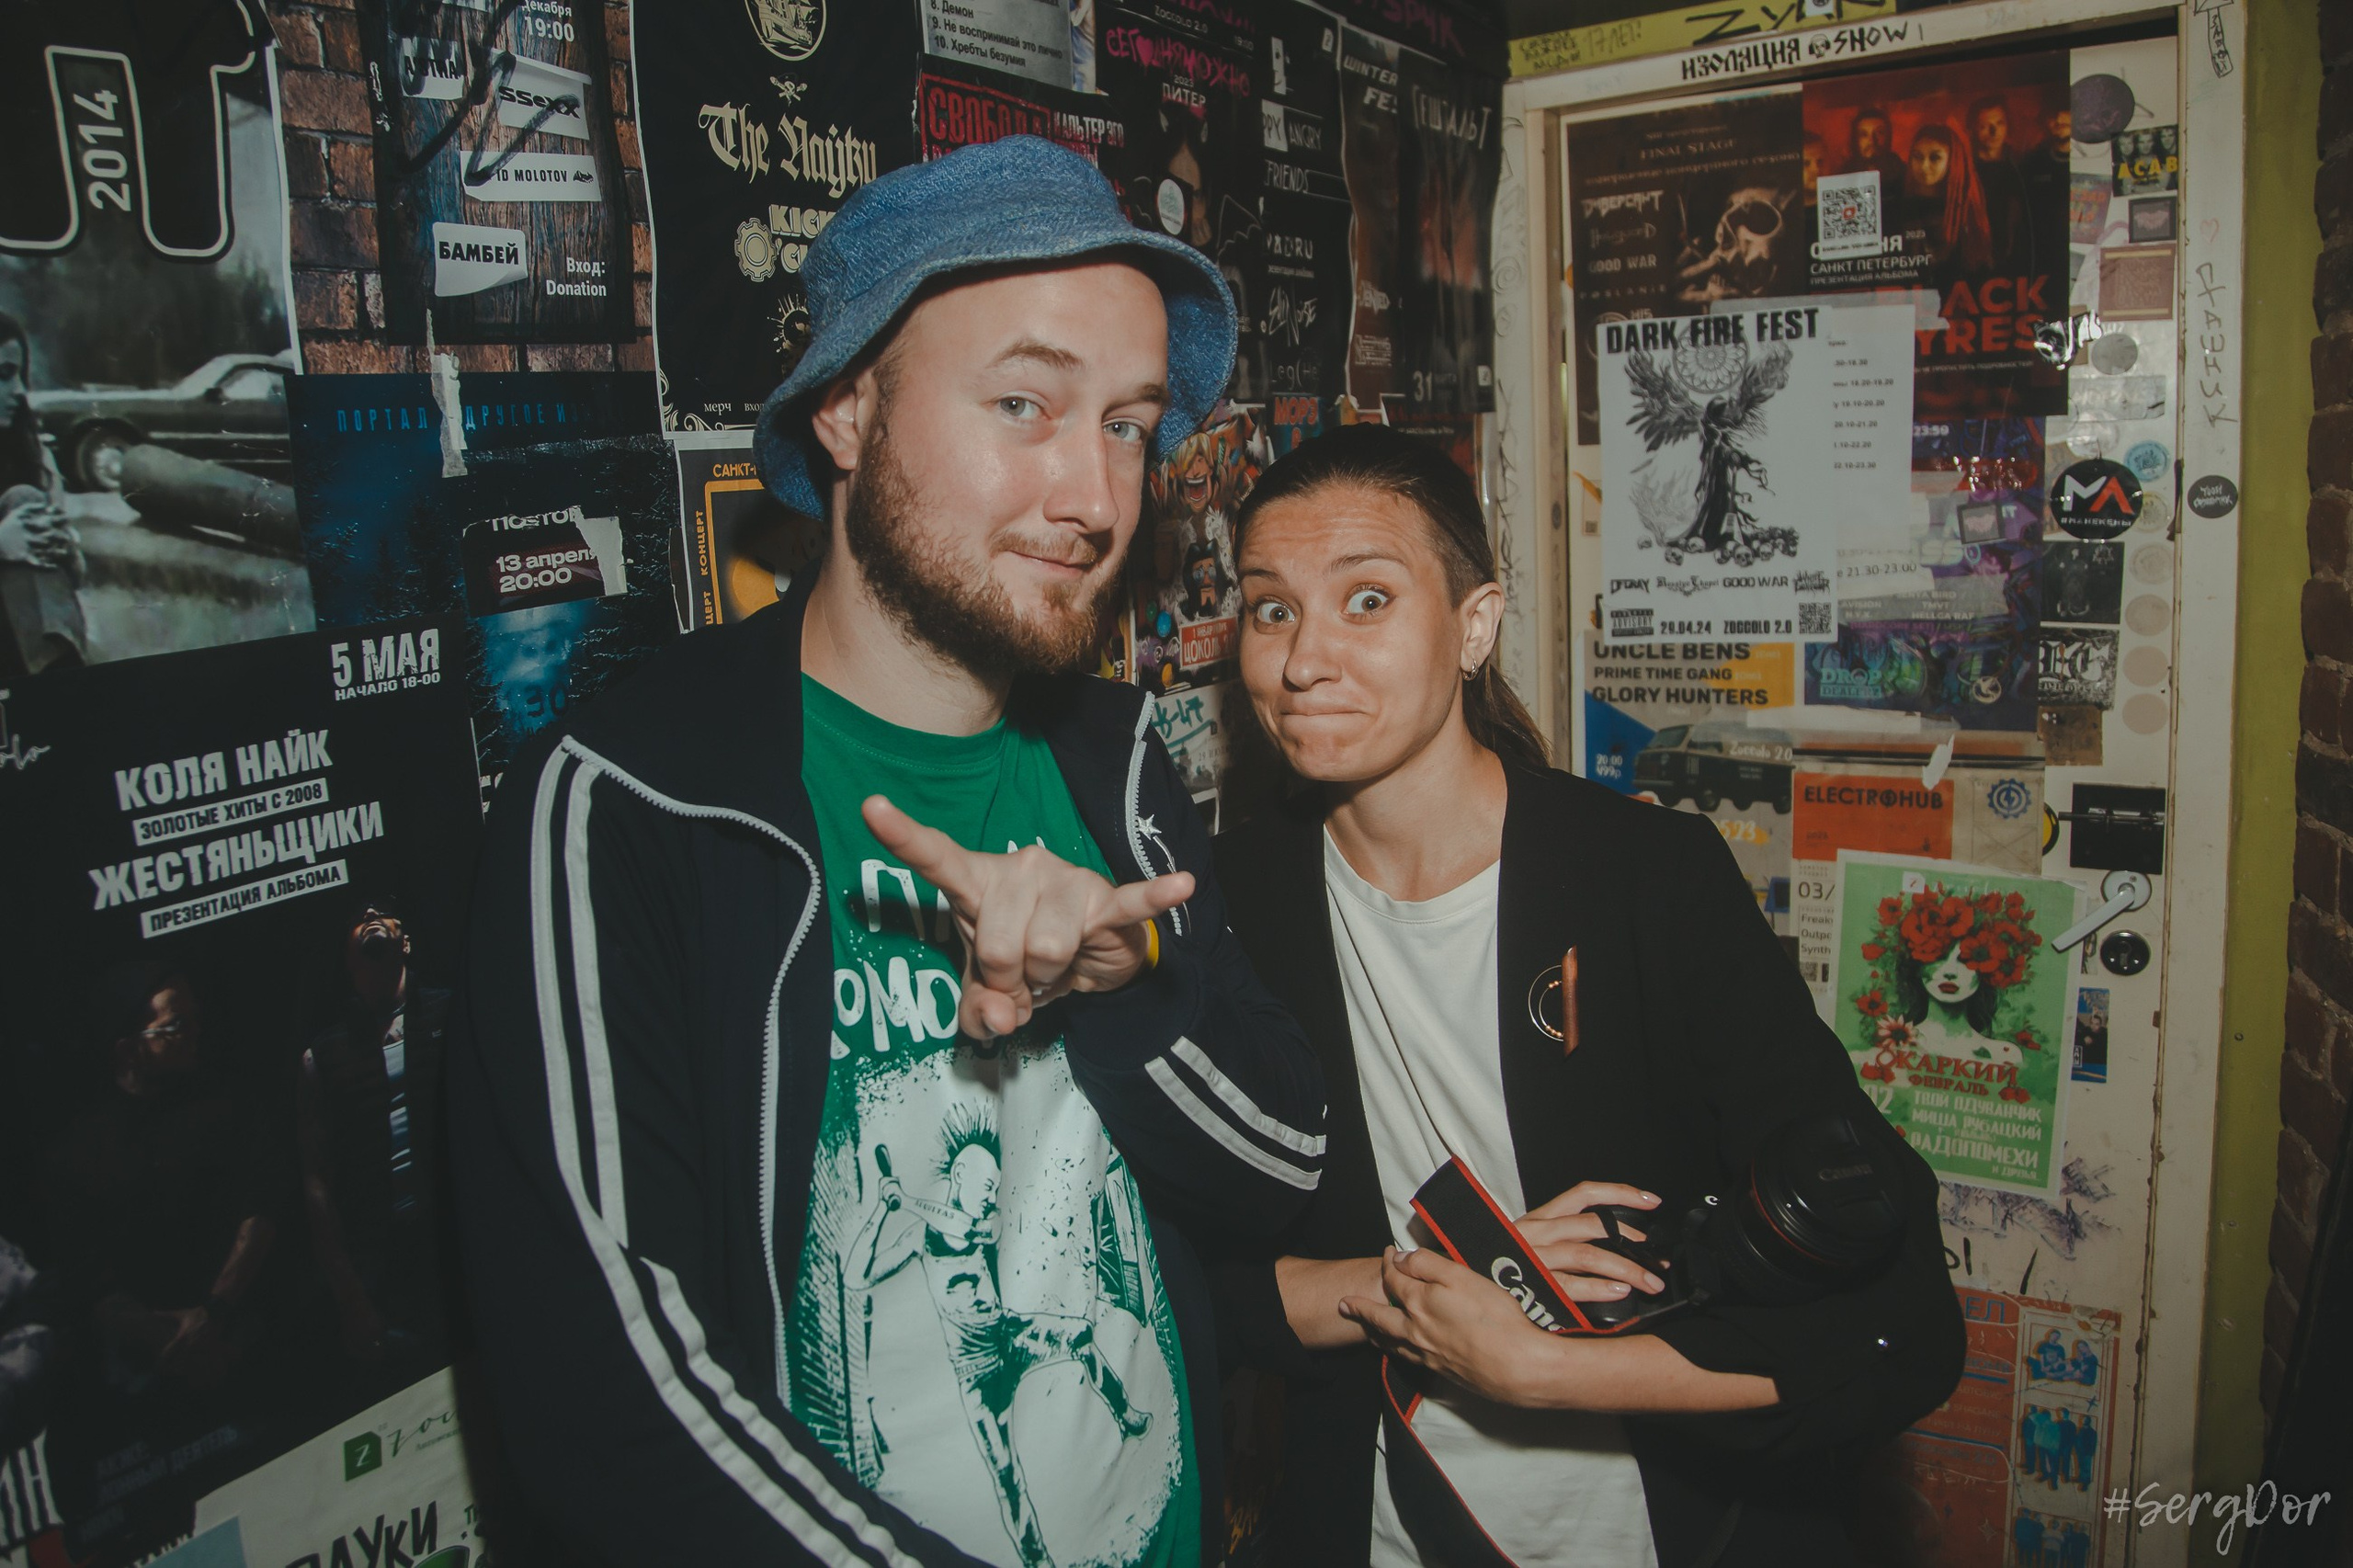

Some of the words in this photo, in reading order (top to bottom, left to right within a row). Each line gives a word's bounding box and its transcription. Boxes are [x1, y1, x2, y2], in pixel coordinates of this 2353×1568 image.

[942, 0, 974, 18] Демон
[524, 17, 574, 42] 19:00
[932, 17, 942, 29] 9.
[944, 19, 957, 33] Не
[960, 24, 1020, 48] воспринимай
[1022, 41, 1036, 52] это
[1038, 47, 1063, 60] лично
[935, 35, 949, 50] 10.
[951, 39, 988, 58] Хребты
[990, 47, 1027, 67] безумия
[1343, 54, 1399, 87] WINTER
[1162, 83, 1207, 108] ПИТЕР
[73, 89, 131, 212] 2014
[699, 102, 770, 184] The
[515, 169, 568, 183] MOLOTOV
[1265, 160, 1309, 193] FRIENDS
[438, 240, 519, 267] БАМБЕЙ
[567, 256, 606, 276] Вход:
[1627, 253, 1657, 269] WAR
[1810, 259, 1854, 275] САНКТ
[1857, 254, 1933, 270] ПЕТЕРБУРГ
[546, 278, 607, 297] Donation
[1811, 272, 1873, 285] ПРЕЗЕНТАЦИЯ
[1874, 269, 1919, 280] АЛЬБОМА
[1607, 320, 1679, 354] DARK
[1689, 313, 1745, 348] FIRE
[1756, 308, 1819, 342] FEST
[1413, 369, 1433, 403] 31
[336, 405, 428, 434] ПОРТАЛ
[465, 404, 545, 431] ДРУГОЕ
[704, 403, 732, 416] мерч
[696, 510, 710, 576] КОНЦЕРТ
[495, 554, 522, 573] 13
[499, 567, 573, 594] 20:00
[1722, 576, 1756, 588] GOOD
[1757, 575, 1789, 587] WAR
[1660, 619, 1711, 635] 29.04.24
[1775, 619, 1792, 634] 2.0
[331, 642, 352, 687] 5
[362, 629, 440, 683] МАЯ
[1594, 641, 1676, 660] UNCLE
[1682, 642, 1751, 660] BENS
[1594, 666, 1643, 679] PRIME
[1646, 666, 1683, 679] TIME
[1687, 667, 1733, 680] GANG
[1821, 668, 1882, 685] DROP
[335, 680, 398, 701] НАЧАЛО
[402, 672, 441, 688] 18-00
[1592, 686, 1664, 704] GLORY
[1665, 687, 1769, 706] HUNTERS
[1775, 745, 1793, 761] 2.0
[115, 751, 228, 812] КОЛЯ
[235, 728, 333, 786] НАЙК
[140, 808, 220, 839] ЗОЛОТЫЕ
[223, 796, 267, 824] ХИТЫ
[271, 791, 282, 810] С
[285, 783, 323, 806] 2008
[1804, 785, 1944, 811] ELECTROHUB
[88, 801, 384, 910] ЖЕСТЯНЬЩИКИ
[150, 885, 261, 933] ПРЕЗЕНТАЦИЯ
[267, 865, 341, 901] АЛЬБОМА
[1890, 1049, 2020, 1088] ЖАРКИЙ
[1908, 1074, 1990, 1096] ФЕВРАЛЬ
[1912, 1108, 1957, 1128] МИША
[1915, 1090, 1949, 1108] ТВОЙ
[1954, 1096, 2042, 1123] ОДУВАНЧИК
[1818, 1164, 1872, 1182] Canon
[1958, 1296, 2005, 1324] ЕЛ
[285, 1500, 438, 1568] АУКИ
